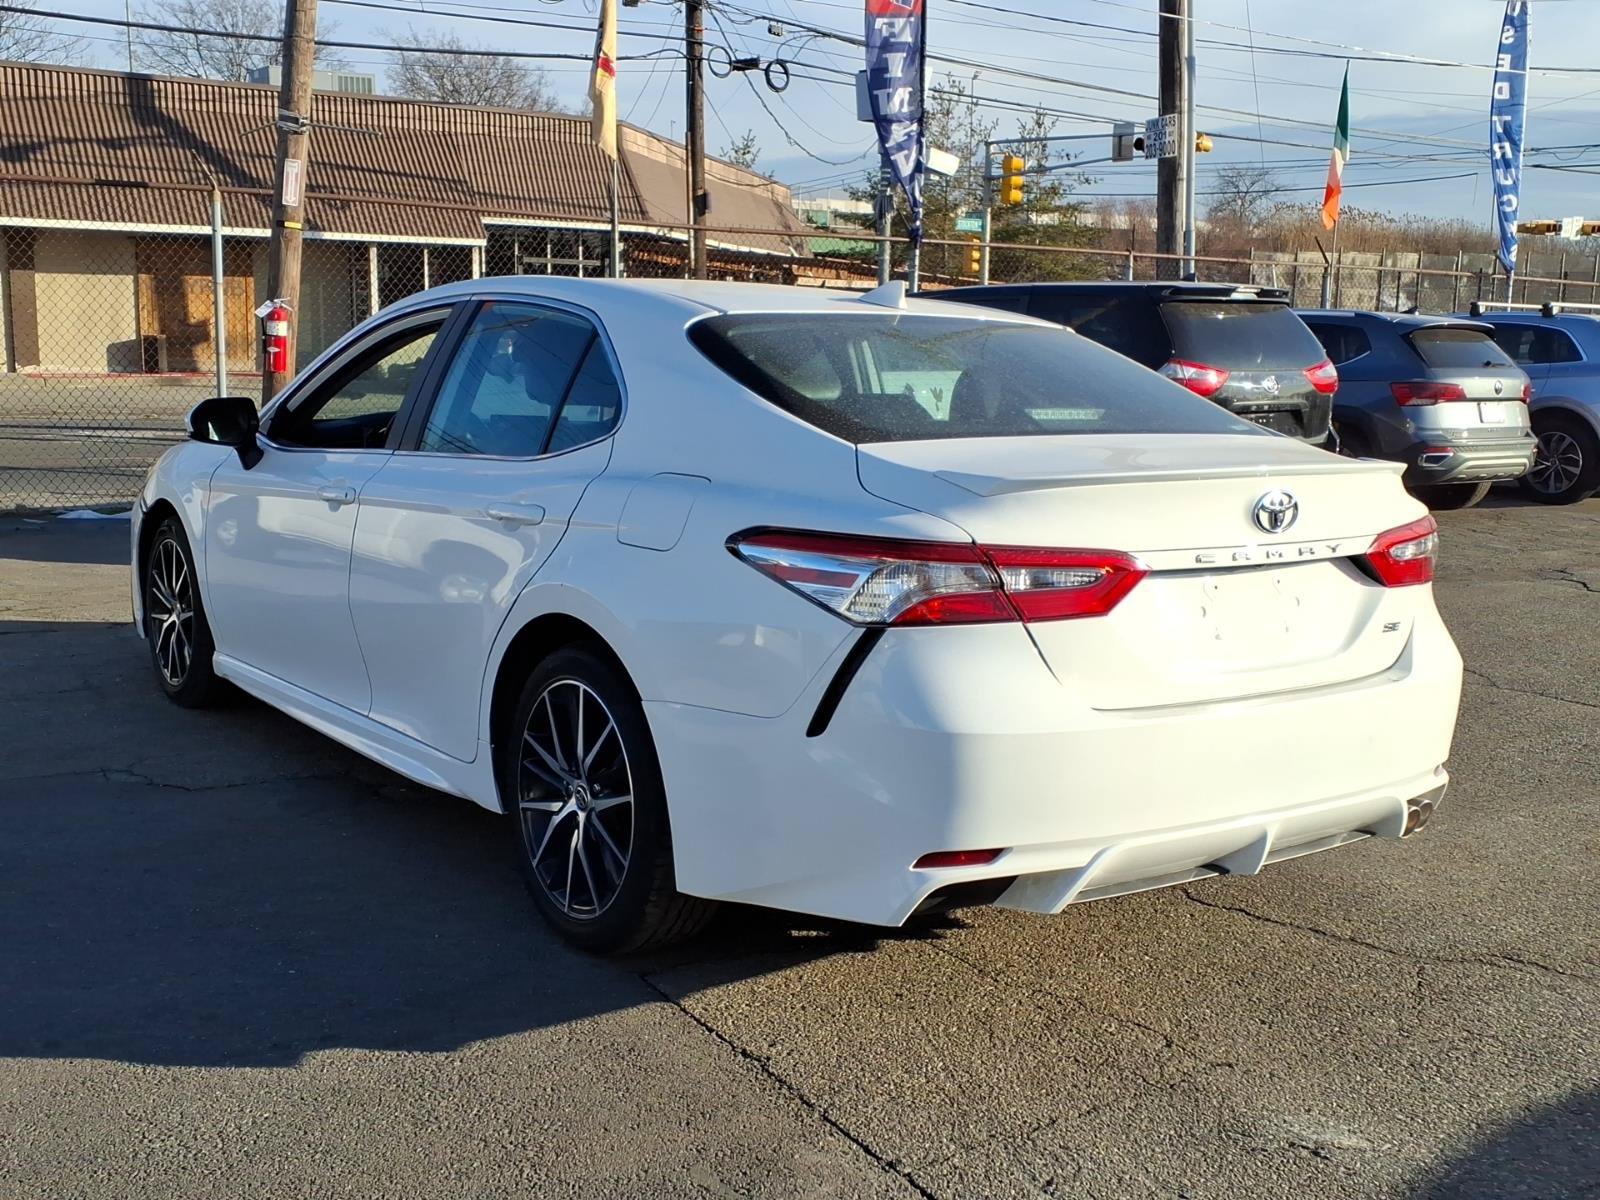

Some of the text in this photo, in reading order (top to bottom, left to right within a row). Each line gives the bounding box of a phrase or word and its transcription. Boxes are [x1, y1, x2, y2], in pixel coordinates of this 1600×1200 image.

[1160, 115, 1176, 129] CARS
[1153, 130, 1167, 142] 201
[1195, 543, 1341, 565] CAMRY
[1382, 621, 1401, 633] SE
